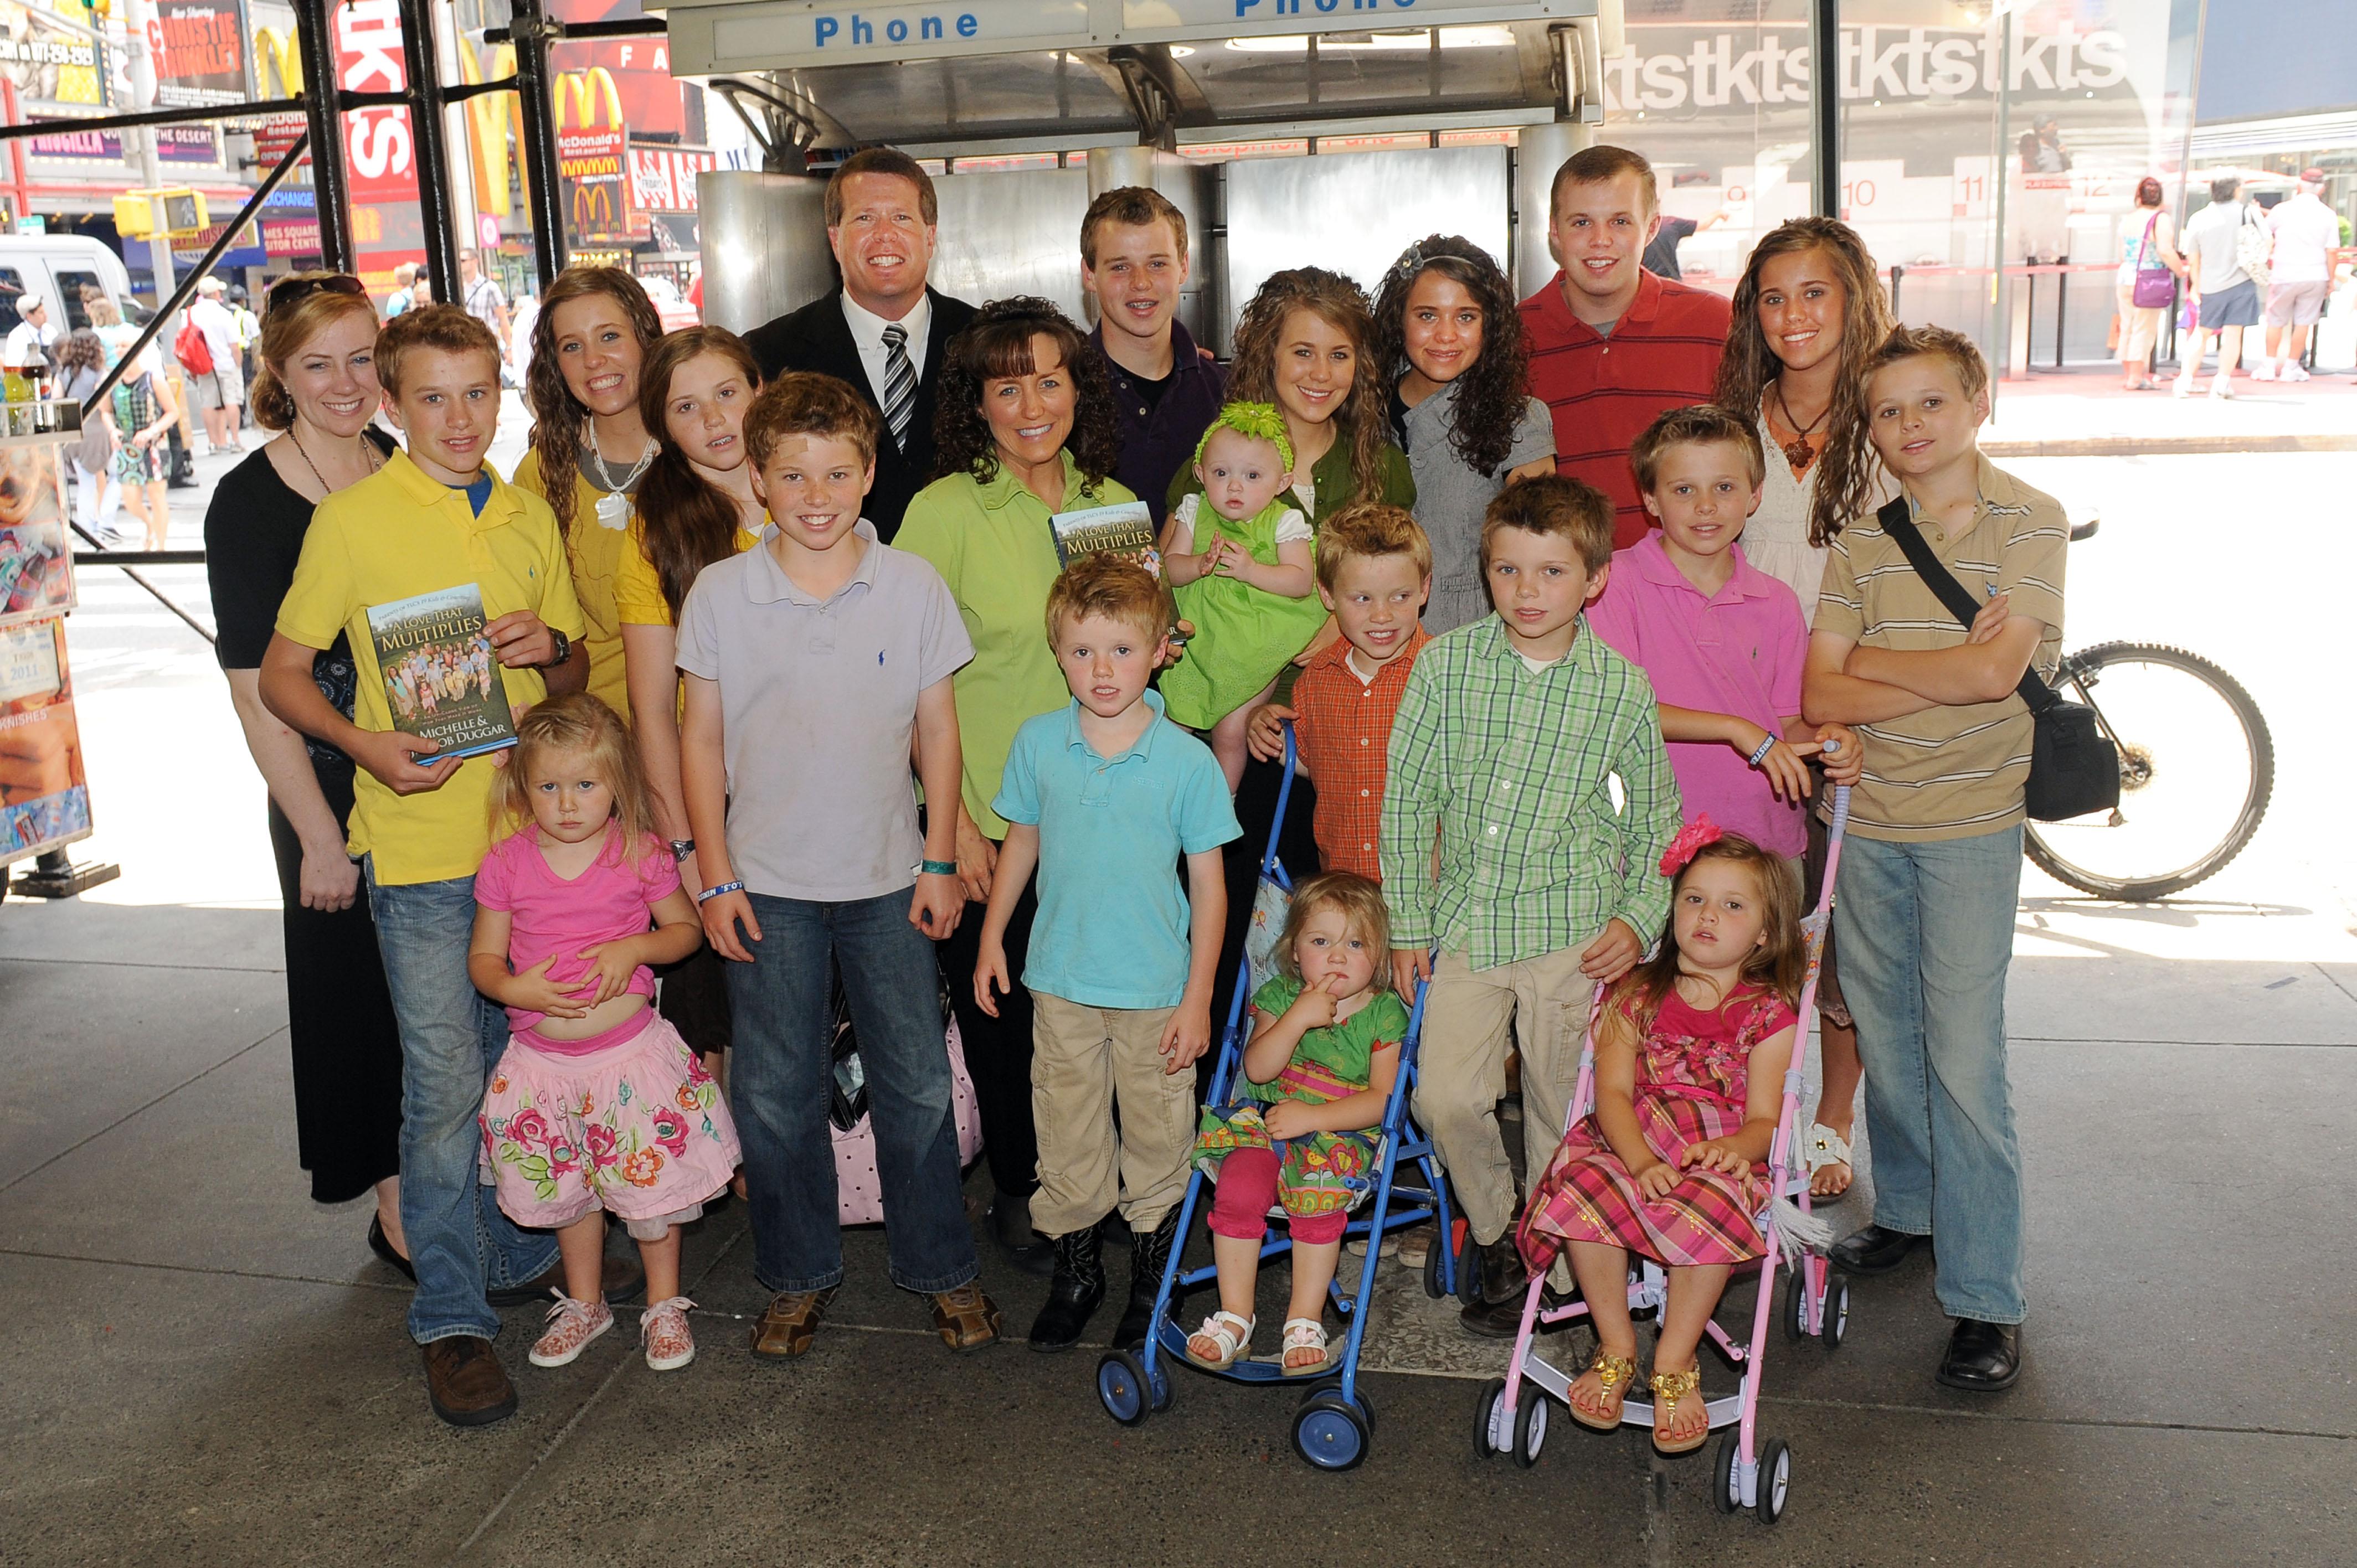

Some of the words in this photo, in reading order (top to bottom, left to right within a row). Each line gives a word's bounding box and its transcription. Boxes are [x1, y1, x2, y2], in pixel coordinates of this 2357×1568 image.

[147, 13, 238, 49] CHRISTIE
[815, 13, 978, 48] Phone
[151, 43, 240, 80] BRINKLEY
[175, 130, 212, 144] DESERT
[1843, 180, 1875, 206] 10
[1960, 176, 1983, 202] 11
[292, 237, 321, 249] CENTE
[1075, 530, 1084, 538] A
[1085, 525, 1109, 537] LOVE
[1111, 520, 1136, 533] THAT
[1066, 530, 1152, 555] MULTIPLIES
[393, 623, 402, 632] A
[403, 613, 431, 629] LOVE
[434, 607, 463, 622] THAT
[382, 615, 482, 652] MULTIPLIES
[420, 718, 476, 739] MICHELLE
[477, 715, 488, 726] &
[438, 737, 454, 747] OB
[456, 724, 507, 747] DUGGAR
